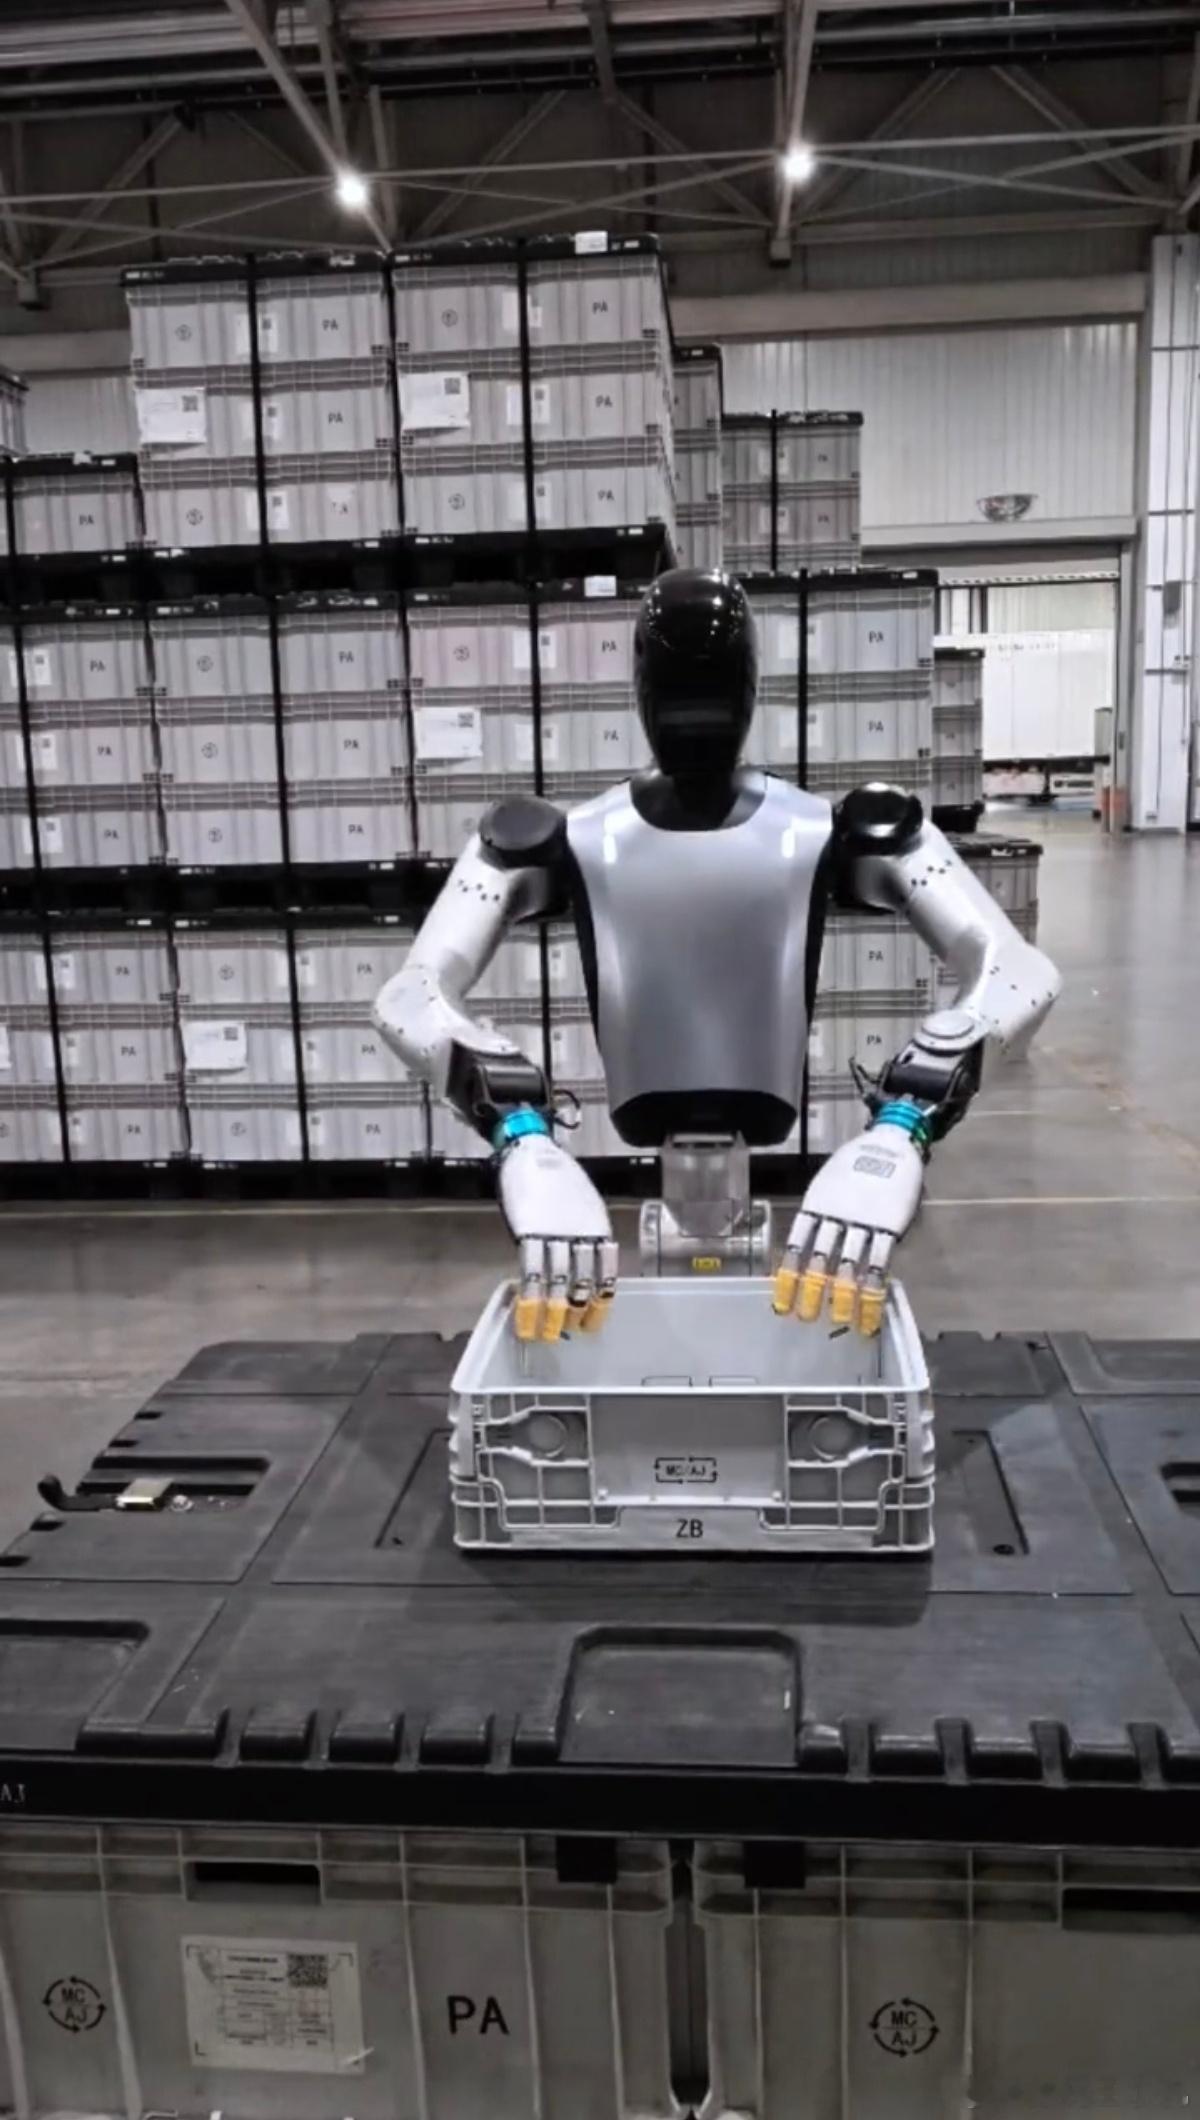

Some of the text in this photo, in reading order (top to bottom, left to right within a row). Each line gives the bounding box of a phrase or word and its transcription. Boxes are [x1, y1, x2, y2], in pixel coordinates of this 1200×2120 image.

[592, 300, 609, 314] PA
[321, 319, 339, 331] PA
[595, 395, 613, 408] PA
[327, 412, 344, 425] PA
[598, 490, 615, 501] PA
[78, 514, 95, 526] PA
[868, 631, 884, 643] PA
[601, 640, 617, 653] PA
[338, 651, 355, 663] PA
[89, 659, 106, 672] PA
[868, 720, 884, 732] PA
[343, 739, 359, 749] PA
[348, 824, 364, 834] PA
[868, 950, 884, 961] PA
[115, 966, 130, 976] PA
[356, 963, 373, 974] PA
[866, 1035, 883, 1045] PA
[120, 1045, 137, 1057] PA
[361, 1044, 377, 1054] PA
[365, 1123, 381, 1134] PA
[676, 1518, 704, 1538] ZB
[61, 1987, 86, 2003] MC
[65, 2006, 88, 2023] AJ
[447, 1995, 510, 2036] PA
[891, 2010, 917, 2027] MC
[891, 2030, 917, 2047] AJ
